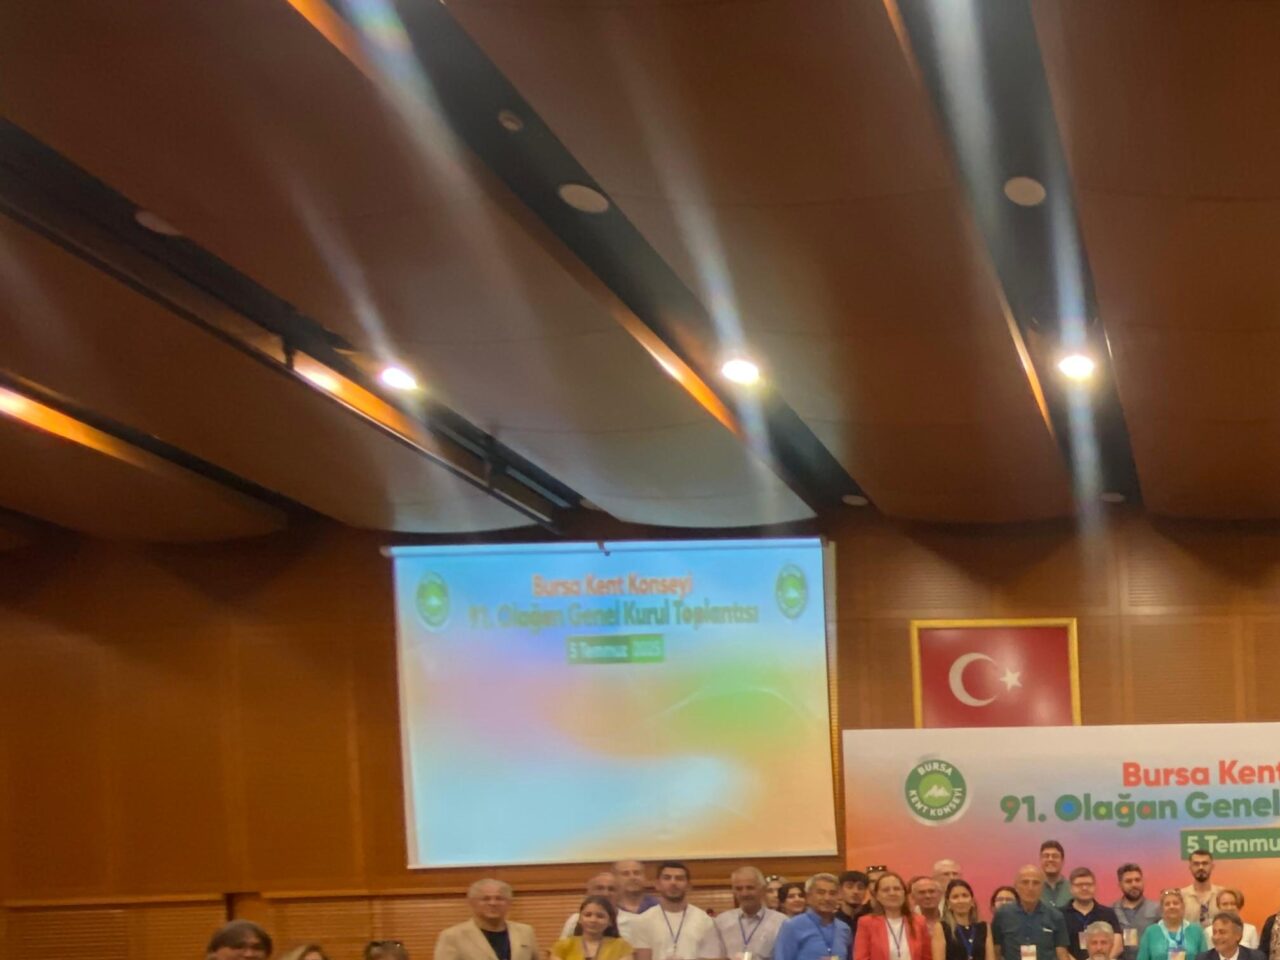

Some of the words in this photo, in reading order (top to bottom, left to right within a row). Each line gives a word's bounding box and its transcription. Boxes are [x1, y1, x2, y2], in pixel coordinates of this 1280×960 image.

[533, 573, 581, 597] Bursa
[586, 571, 624, 595] Kent
[627, 570, 693, 599] Konseyi
[568, 600, 619, 627] Genel
[624, 599, 669, 626] Kurul
[917, 761, 953, 776] BURSA
[1122, 762, 1209, 787] Bursa
[908, 789, 930, 813] KENT
[1000, 795, 1047, 823] 91.
[1054, 793, 1179, 828] Olağan
[1185, 788, 1280, 819] Genel
[1186, 836, 1199, 854] 5
